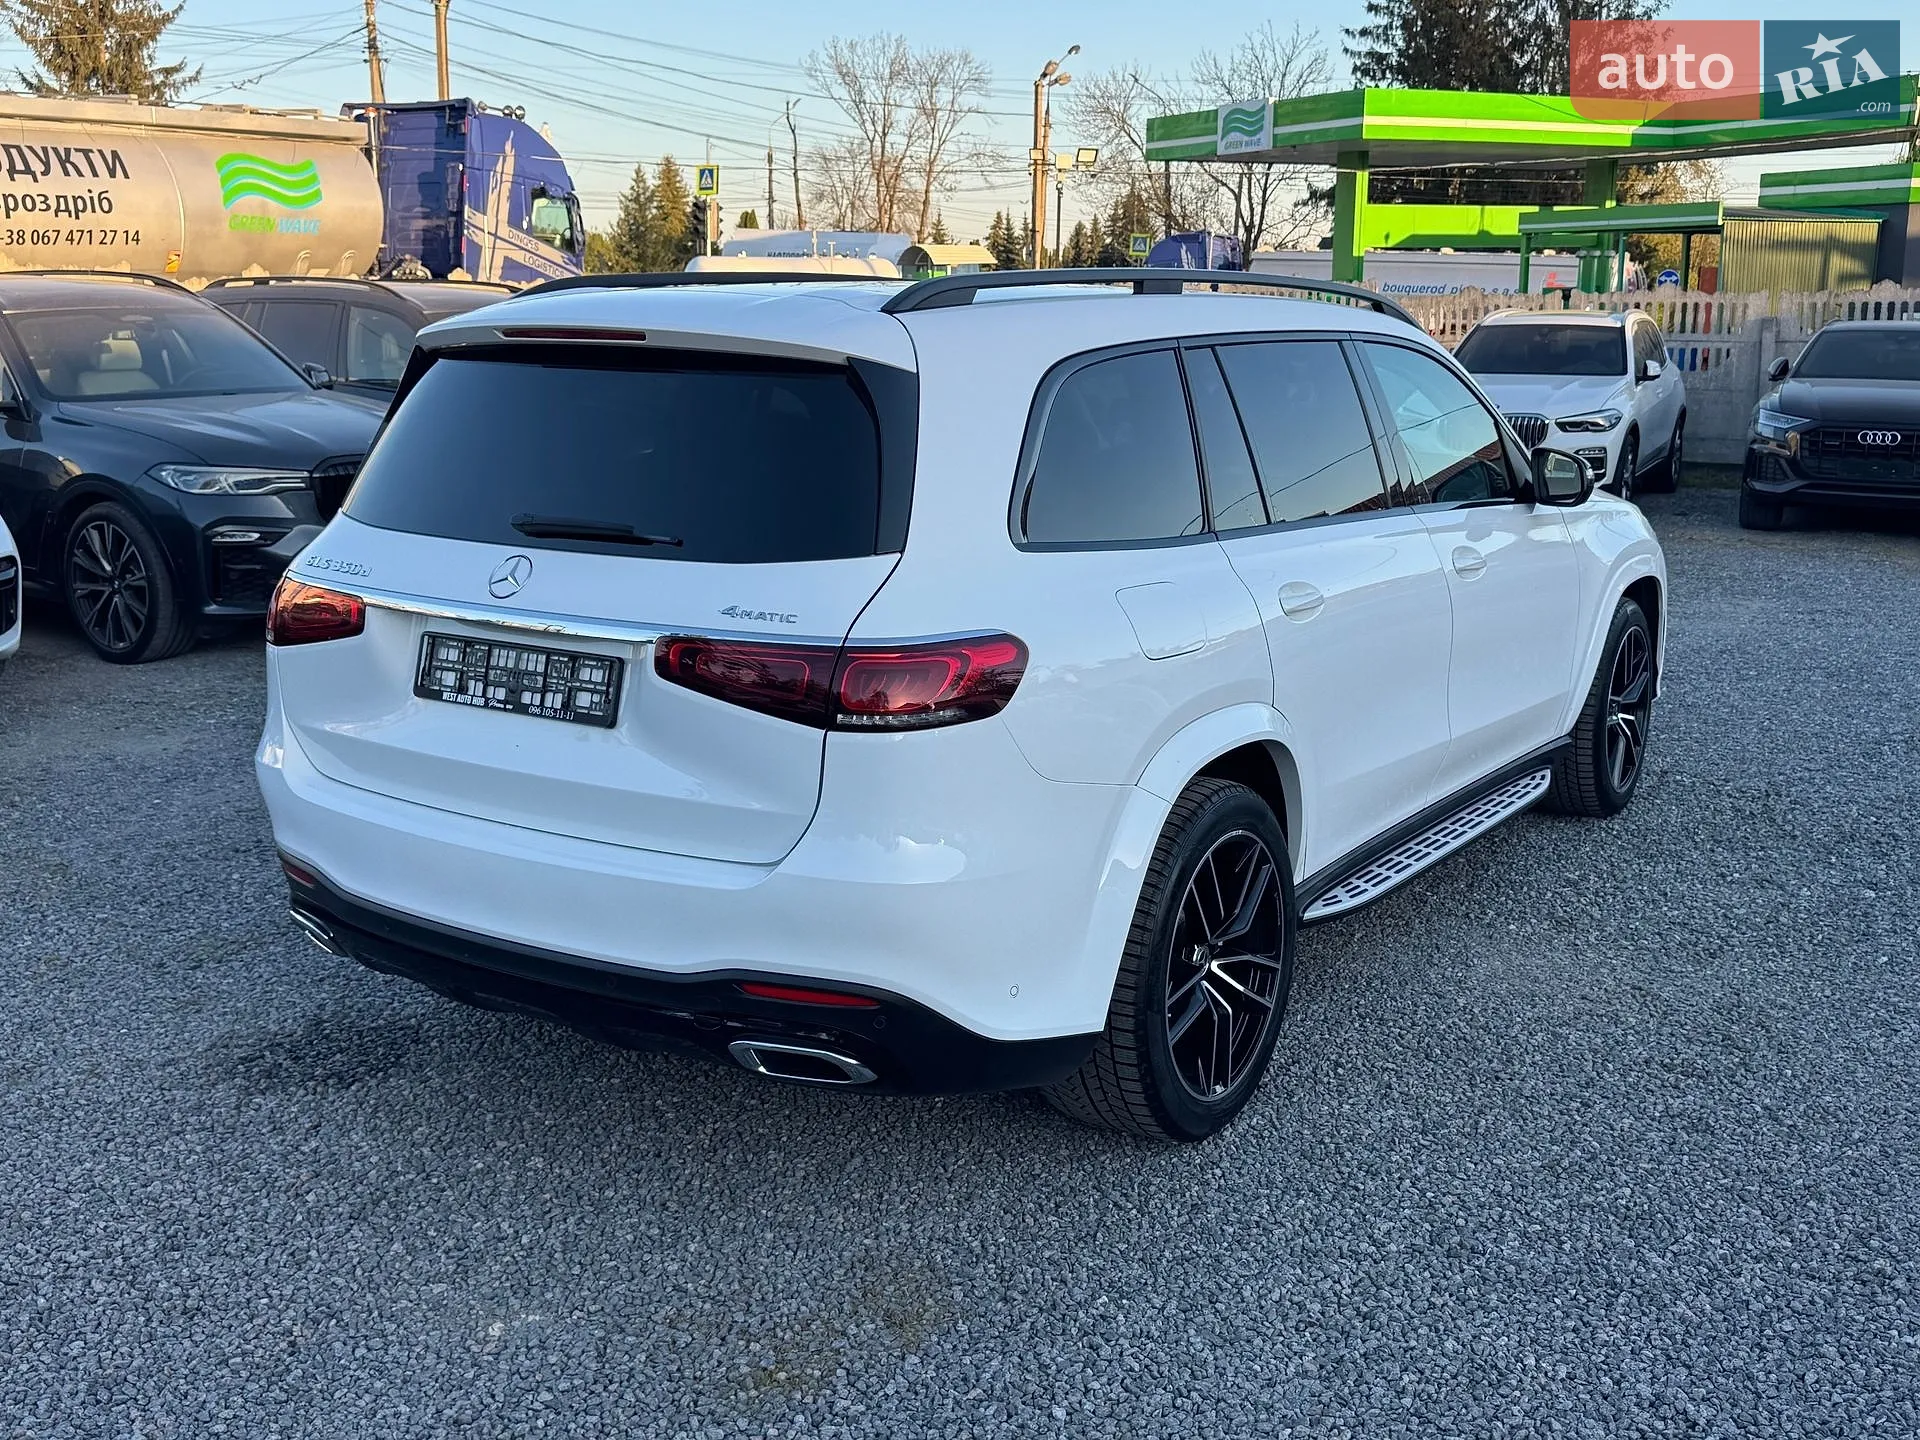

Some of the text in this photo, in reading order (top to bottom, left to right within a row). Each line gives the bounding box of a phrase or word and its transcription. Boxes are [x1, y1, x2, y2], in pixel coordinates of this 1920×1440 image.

[0, 143, 130, 183] ДУКТИ
[228, 213, 321, 235] GREEN WAVE
[30, 228, 61, 246] 067
[65, 228, 93, 246] 471
[98, 228, 118, 246] 27
[122, 228, 141, 246] 14
[1382, 282, 1447, 296] bouquerod
[718, 605, 799, 624] 4MATIC
[442, 691, 457, 702] WEST
[456, 693, 472, 705] AUTO
[528, 705, 541, 715] 096
